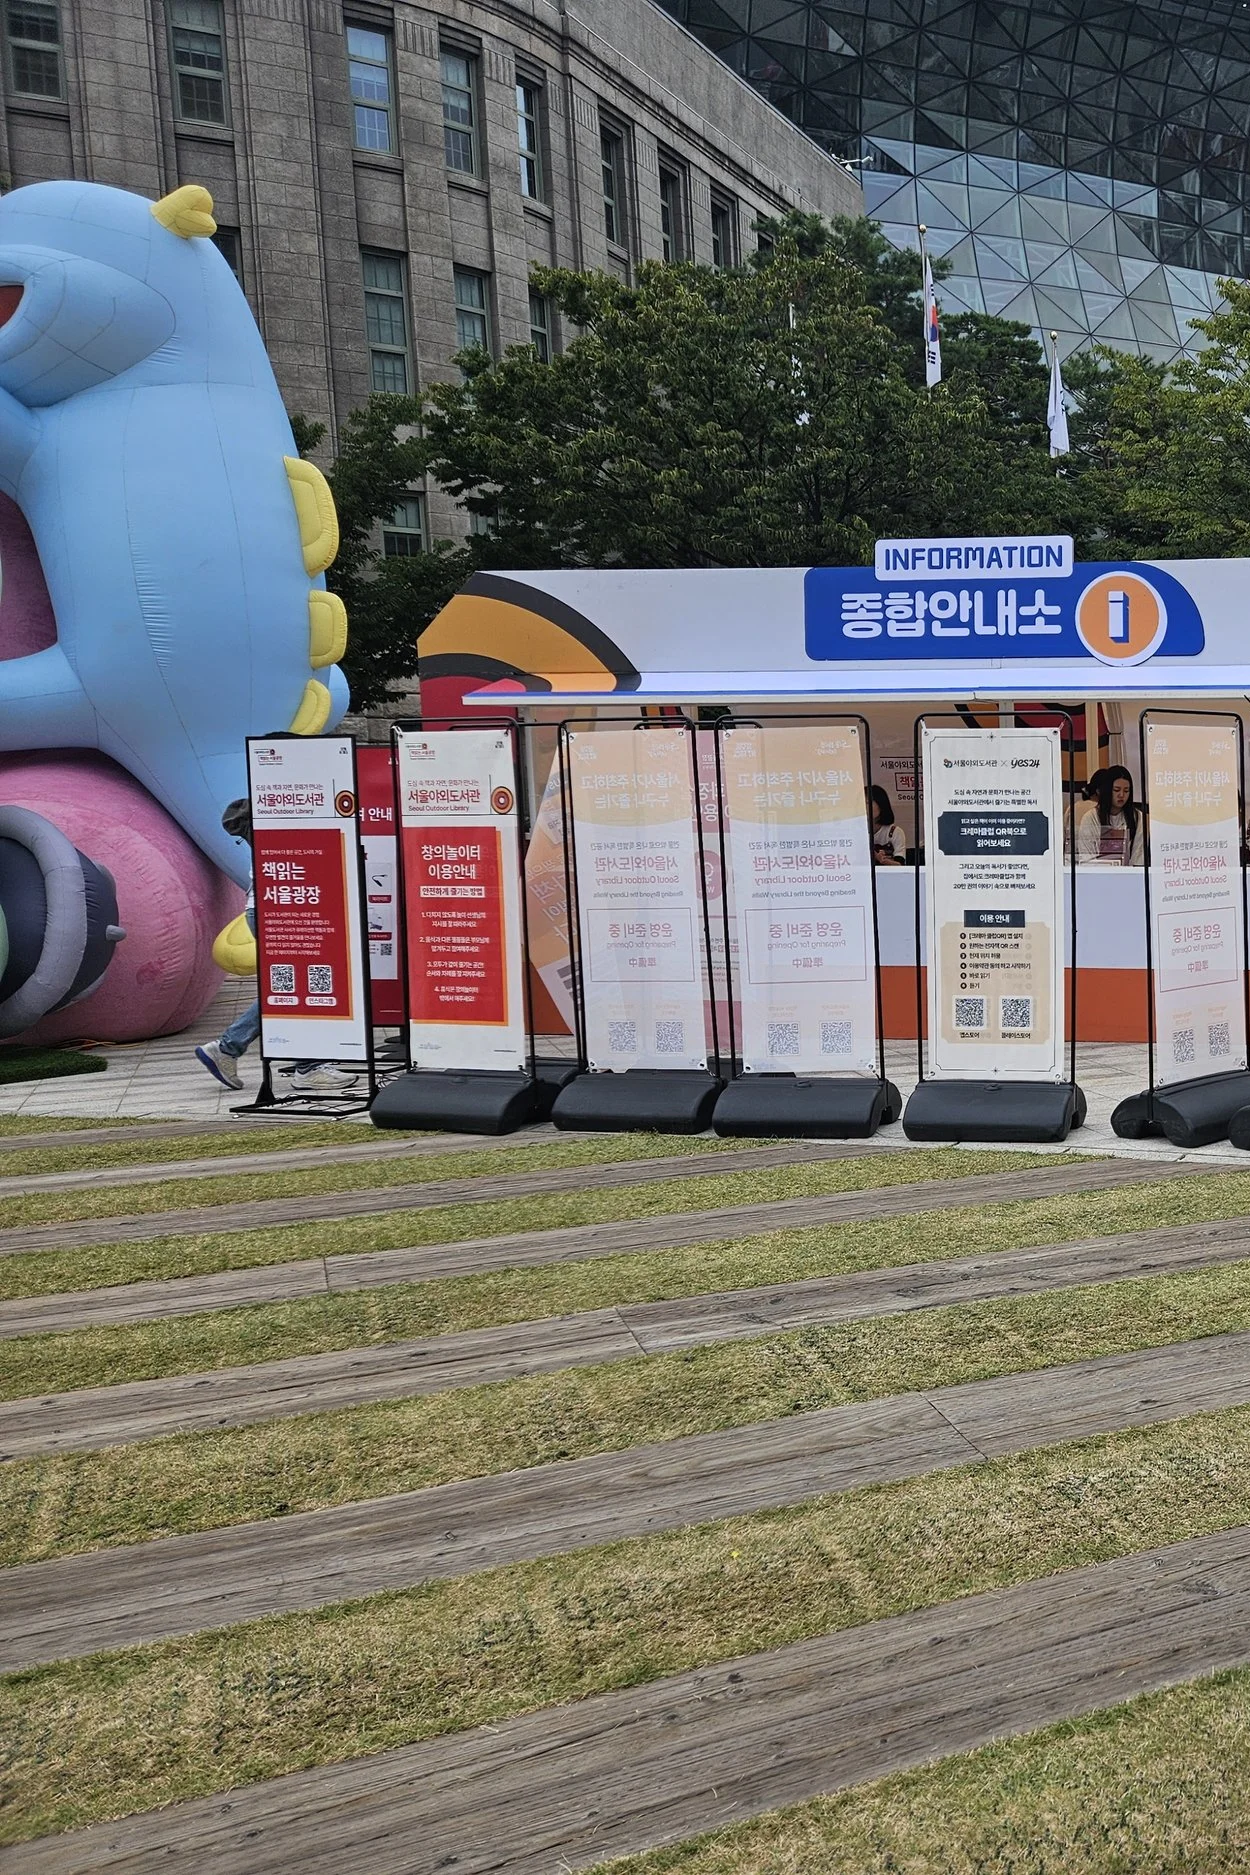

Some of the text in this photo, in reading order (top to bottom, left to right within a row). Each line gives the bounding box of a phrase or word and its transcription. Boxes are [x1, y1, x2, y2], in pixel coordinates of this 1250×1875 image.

[885, 545, 1063, 571] INFORMATION
[841, 589, 1062, 639] 종합안내소
[257, 793, 324, 806] 서울야외도서관
[409, 789, 480, 803] 서울야외도서관
[369, 807, 392, 821] 안내
[977, 839, 1011, 847] 읽어보세요
[421, 845, 480, 861] 창의놀이터
[262, 861, 306, 880] 책읽는
[429, 864, 476, 880] 이용안내
[264, 885, 320, 904] 서울광장
[422, 887, 483, 896] 안전하게 즐기는 방법
[980, 914, 1010, 923] 이용 안내
